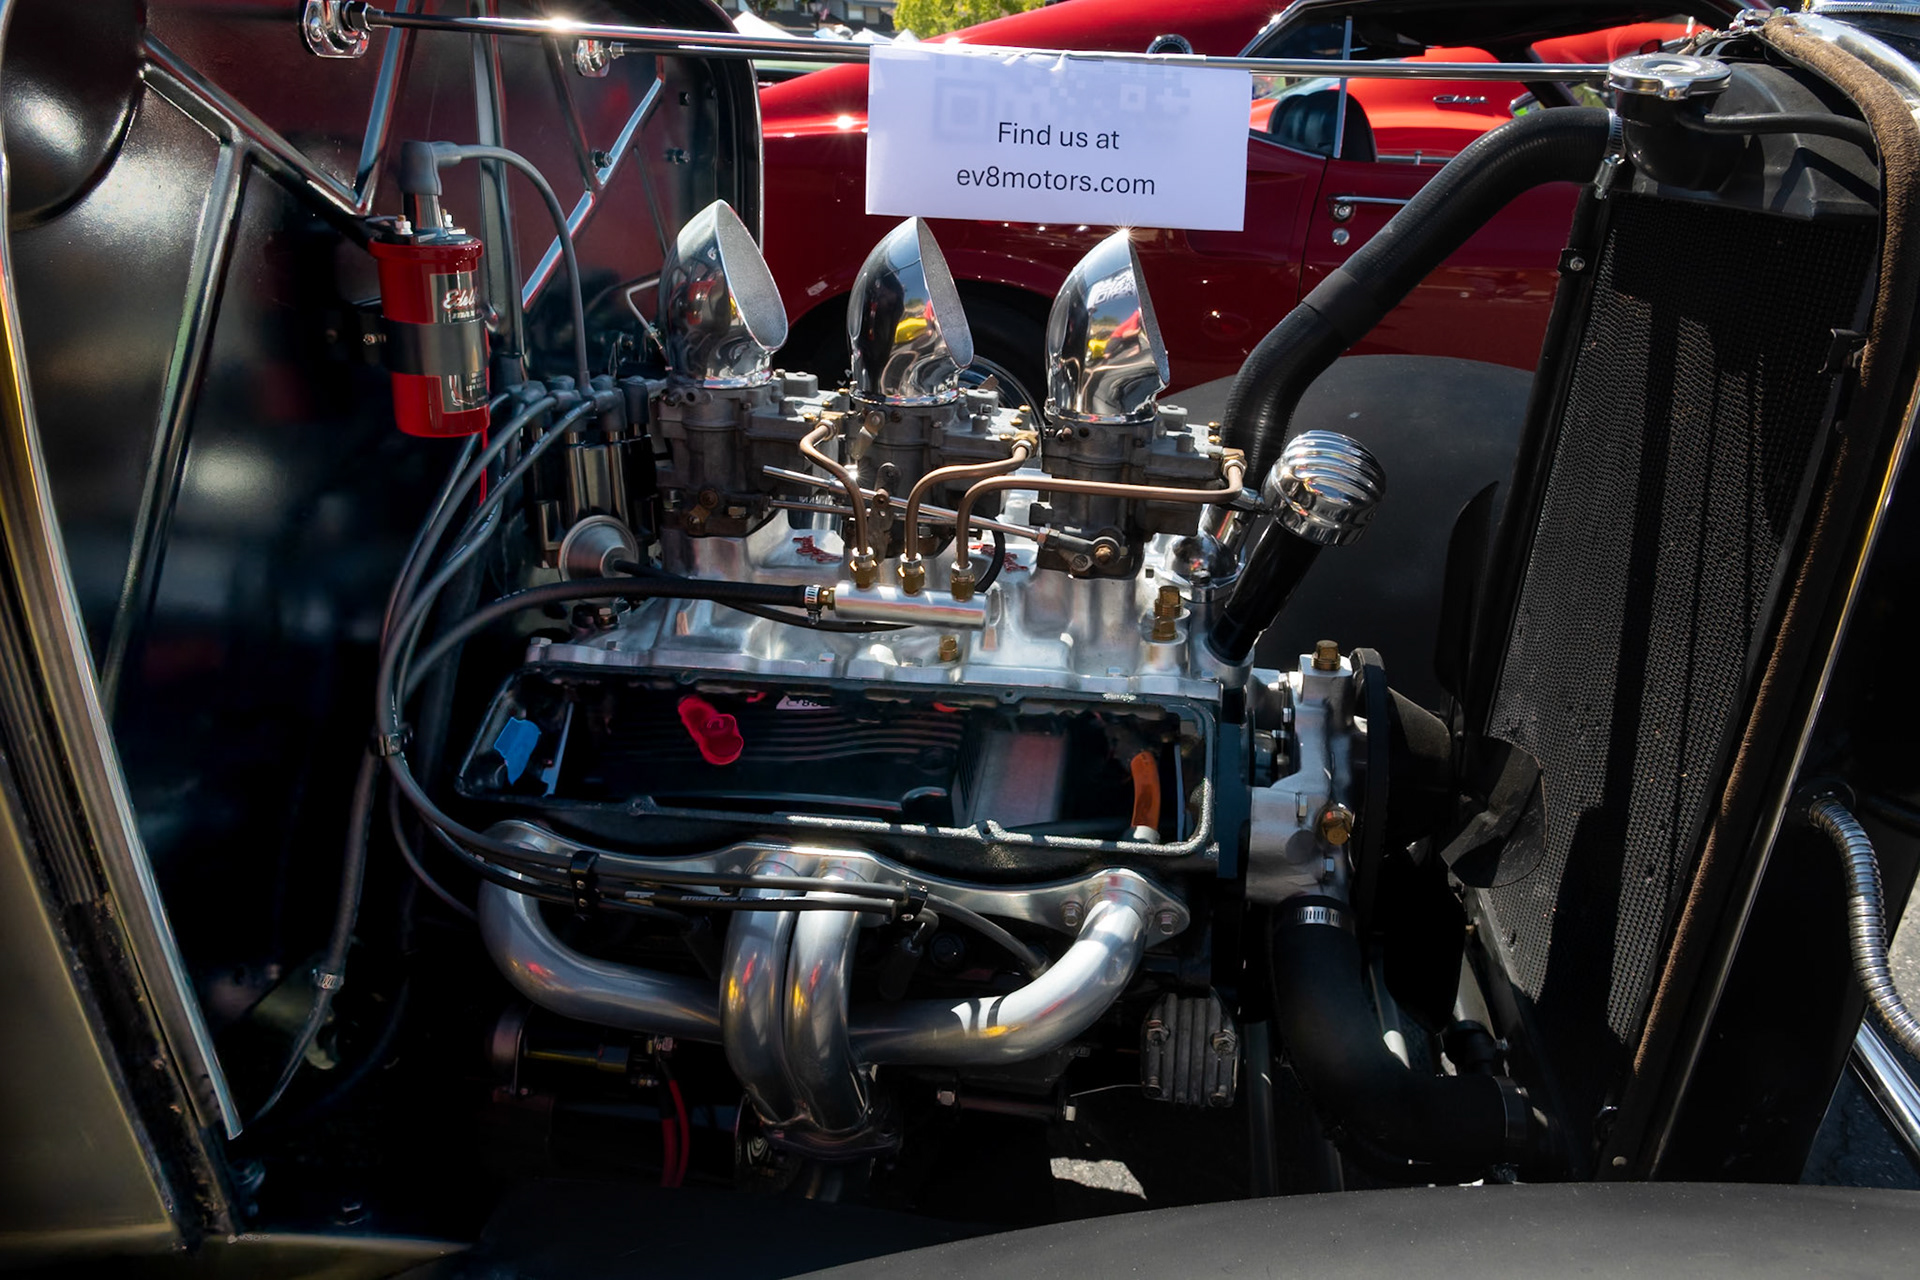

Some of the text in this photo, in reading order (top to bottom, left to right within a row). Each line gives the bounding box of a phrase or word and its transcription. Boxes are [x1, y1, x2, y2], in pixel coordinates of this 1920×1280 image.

[998, 121, 1120, 150] Find us at
[956, 165, 1155, 196] ev8motors.com
